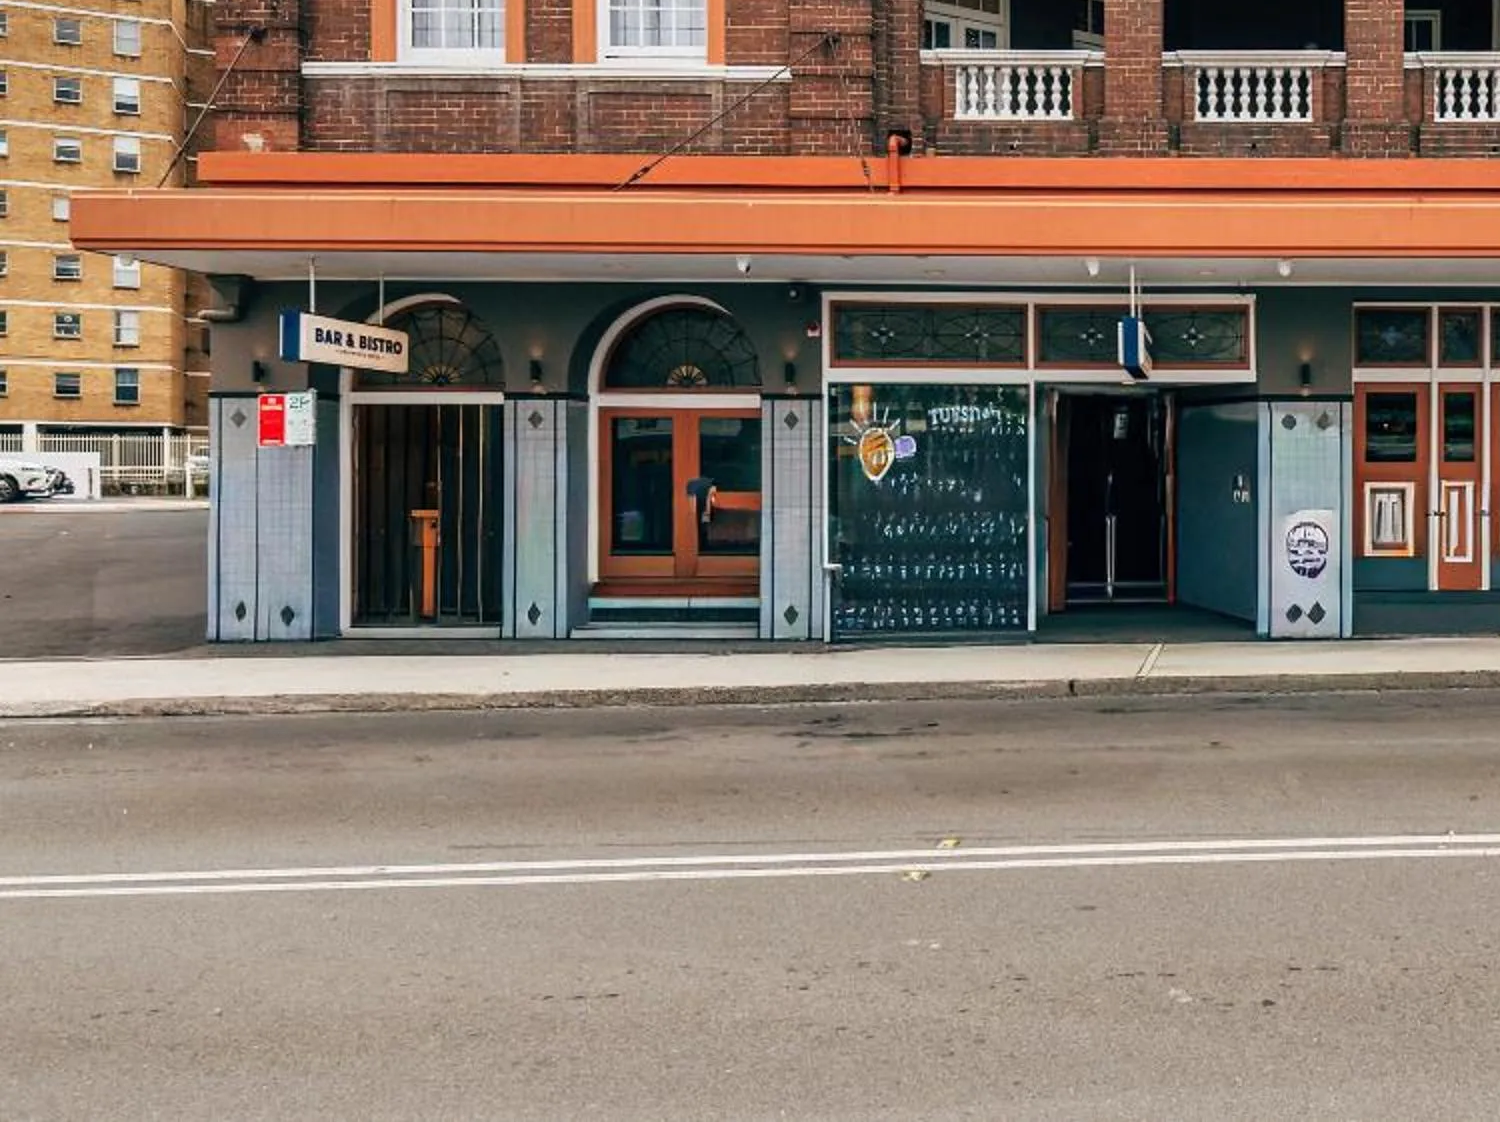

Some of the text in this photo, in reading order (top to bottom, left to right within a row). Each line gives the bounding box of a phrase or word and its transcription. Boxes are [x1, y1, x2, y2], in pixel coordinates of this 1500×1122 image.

[315, 328, 343, 347] BAR
[346, 333, 354, 348] &
[360, 336, 402, 355] BISTRO
